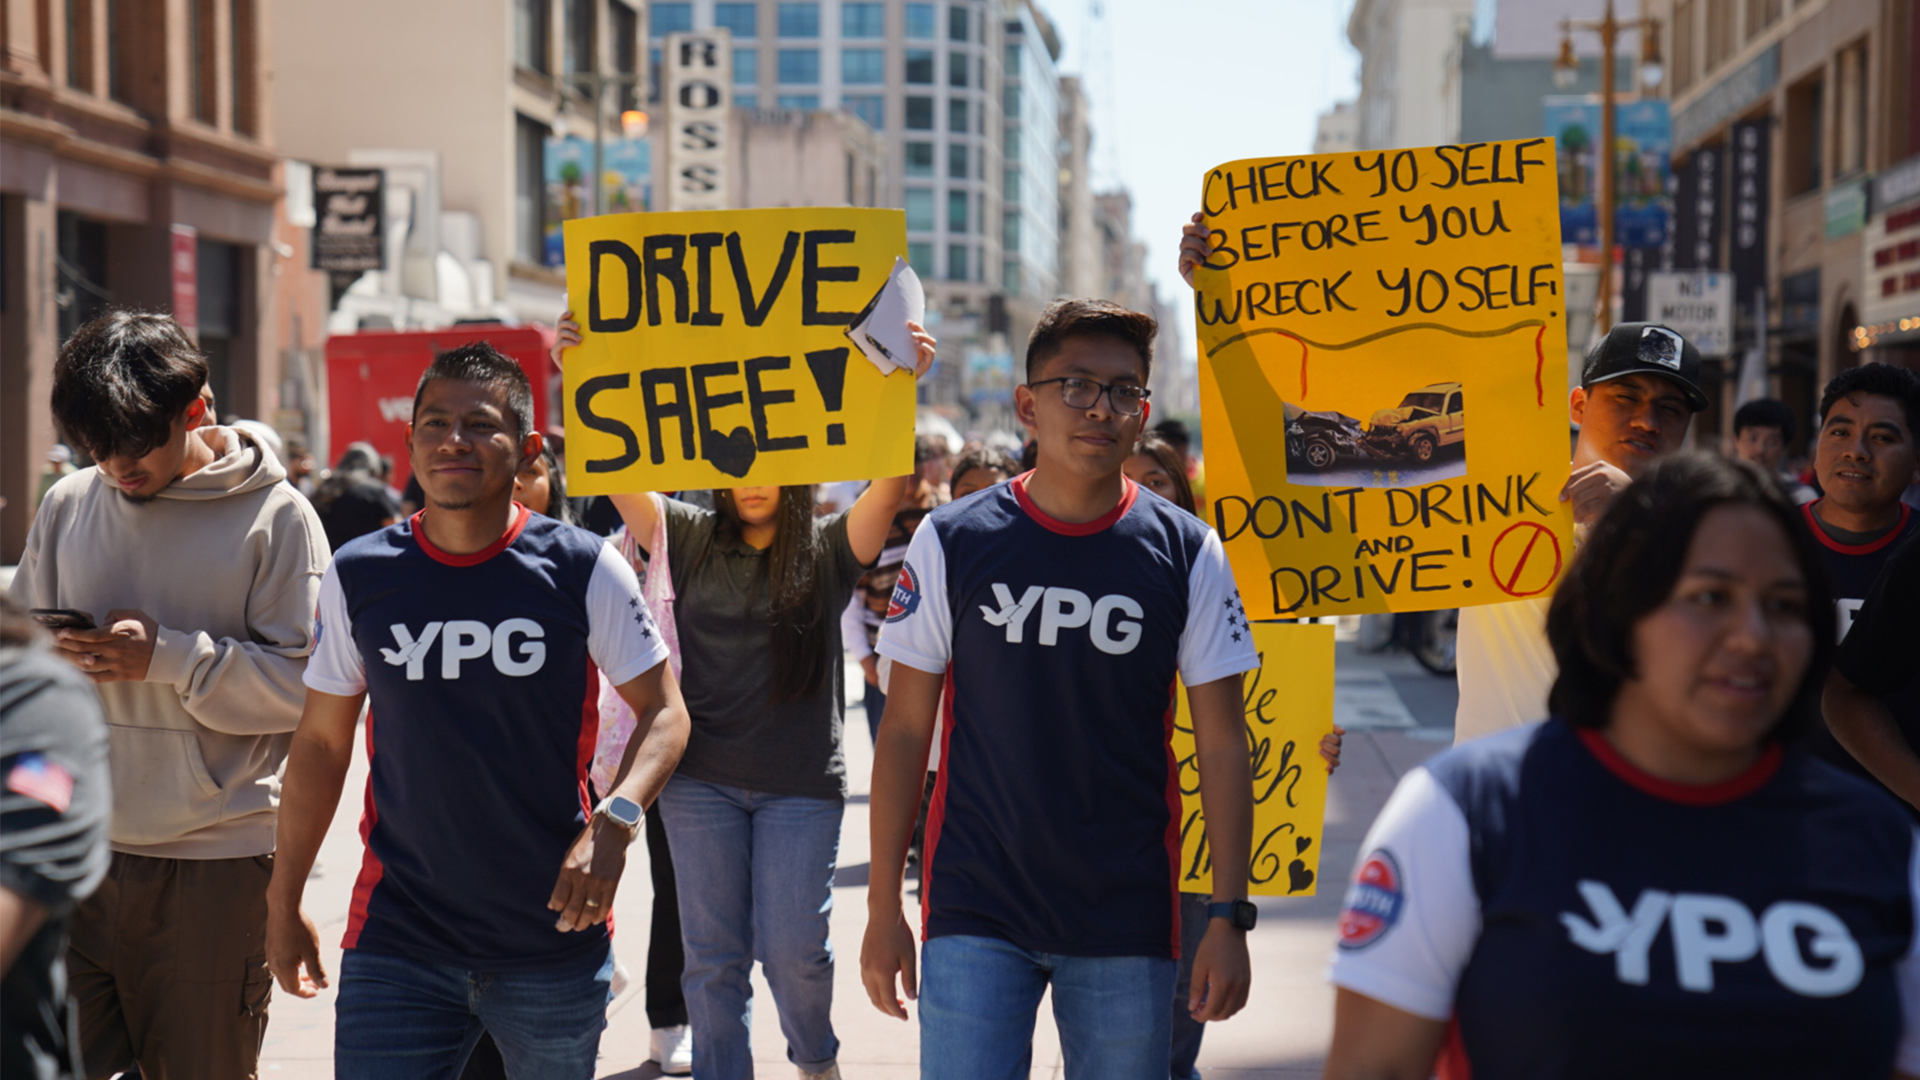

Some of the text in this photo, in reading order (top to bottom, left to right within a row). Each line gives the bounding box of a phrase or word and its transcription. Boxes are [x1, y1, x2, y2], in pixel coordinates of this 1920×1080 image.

[680, 41, 719, 192] ROSS
[1203, 138, 1545, 217] CHECK YO SELF
[1738, 126, 1758, 247] GRAND
[1202, 200, 1511, 270] BEFORE YOU
[589, 229, 860, 332] DRIVE
[1197, 271, 1358, 325] WRECK
[1662, 304, 1718, 322] MOTOR
[575, 347, 850, 473] SAFE!
[1386, 472, 1554, 528] DRINK
[1270, 534, 1473, 614] DRIVE!
[1355, 535, 1414, 559] AND
[379, 618, 547, 681] YPG
[979, 583, 1144, 655] YPG
[1560, 879, 1864, 997] YPG
